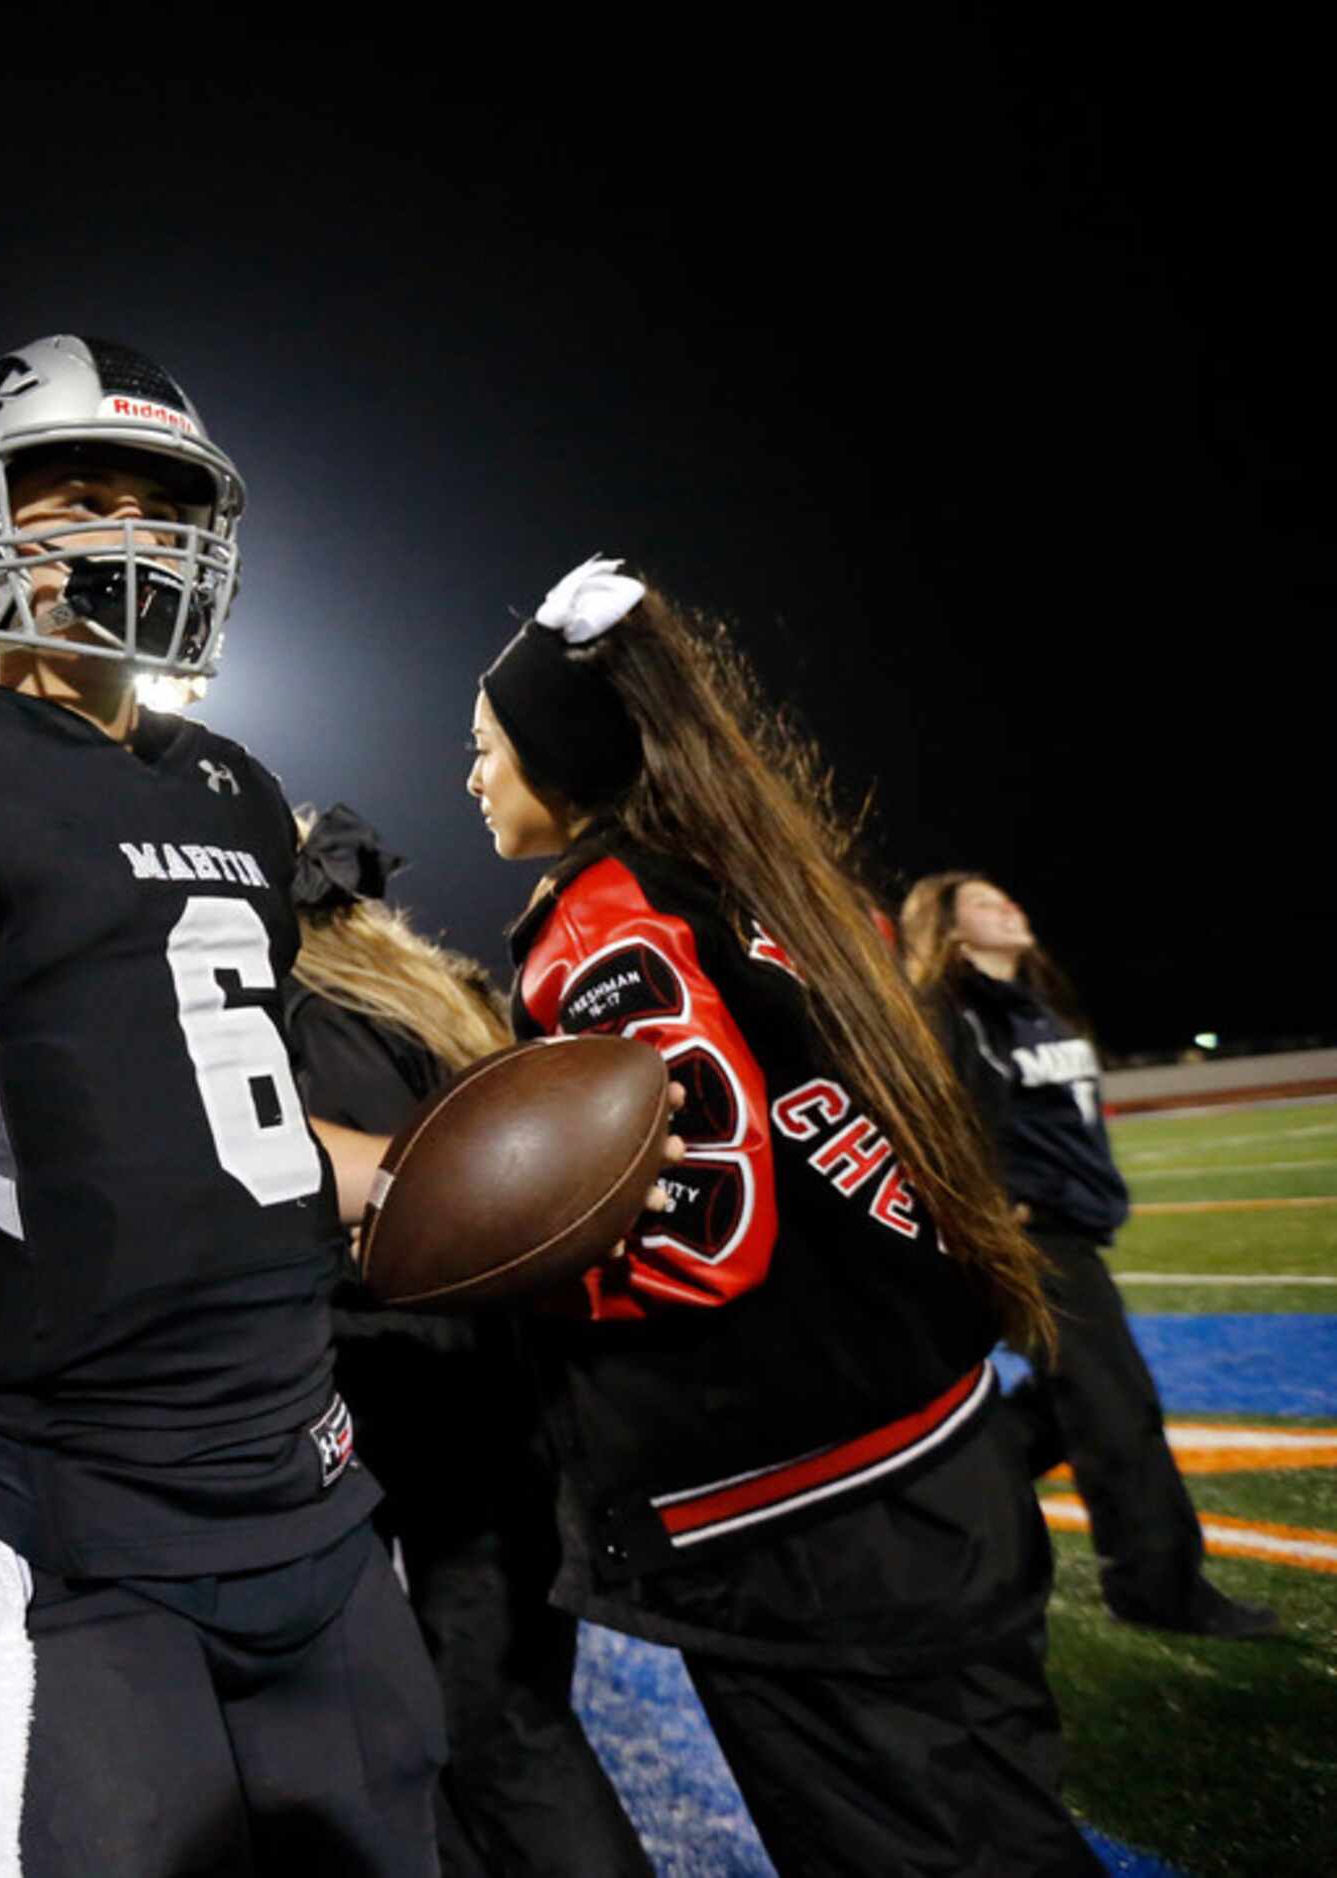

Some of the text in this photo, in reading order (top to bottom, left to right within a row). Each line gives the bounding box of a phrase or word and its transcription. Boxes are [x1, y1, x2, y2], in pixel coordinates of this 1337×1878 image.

[113, 398, 191, 433] Riddell
[119, 842, 270, 889] MARTIN
[567, 970, 642, 1018] FRESHMAN
[165, 896, 322, 1207] 6
[770, 1077, 949, 1255] CHE
